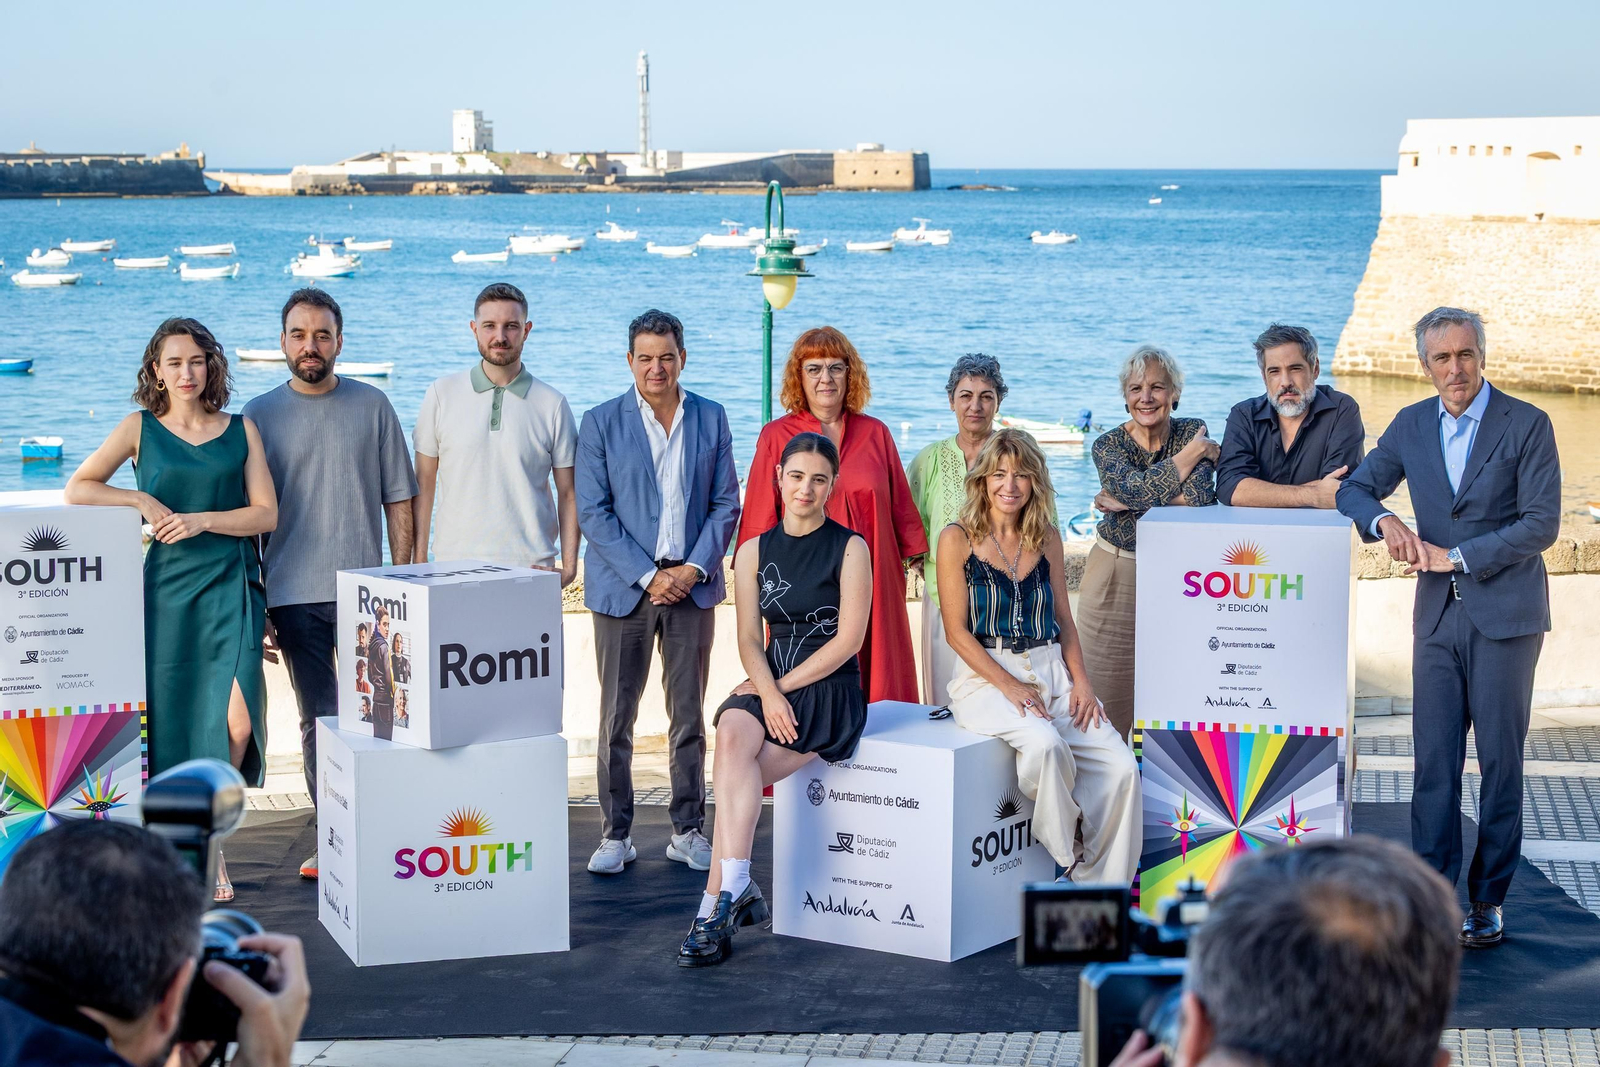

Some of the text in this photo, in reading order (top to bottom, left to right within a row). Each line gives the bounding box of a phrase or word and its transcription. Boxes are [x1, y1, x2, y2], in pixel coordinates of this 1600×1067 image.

[0, 556, 102, 586] OUTH
[382, 565, 512, 580] Romi
[1182, 570, 1303, 600] SOUTH
[29, 588, 69, 598] EDICIÓN
[358, 585, 407, 621] Romi
[1228, 603, 1269, 613] EDICIÓN
[20, 627, 84, 639] Ayuntamiento de Cádiz
[1221, 641, 1254, 649] Ayuntamiento
[439, 632, 550, 689] Romi
[56, 680, 95, 690] WOMACK
[1204, 695, 1251, 708] Andalucía
[827, 761, 897, 774] OFFICIAL ORGANIZATIONS
[828, 788, 920, 810] Ayuntamiento de Cádiz
[857, 834, 897, 848] Diputación
[857, 846, 890, 859] de Cádiz
[393, 841, 533, 880] SOUTH
[999, 857, 1022, 873] EDICIÓN
[447, 878, 493, 892] EDICIÓN
[831, 876, 846, 884] WITH
[847, 878, 858, 886] THE
[859, 879, 883, 889] SUPPORT
[802, 890, 881, 922] Andalucía
